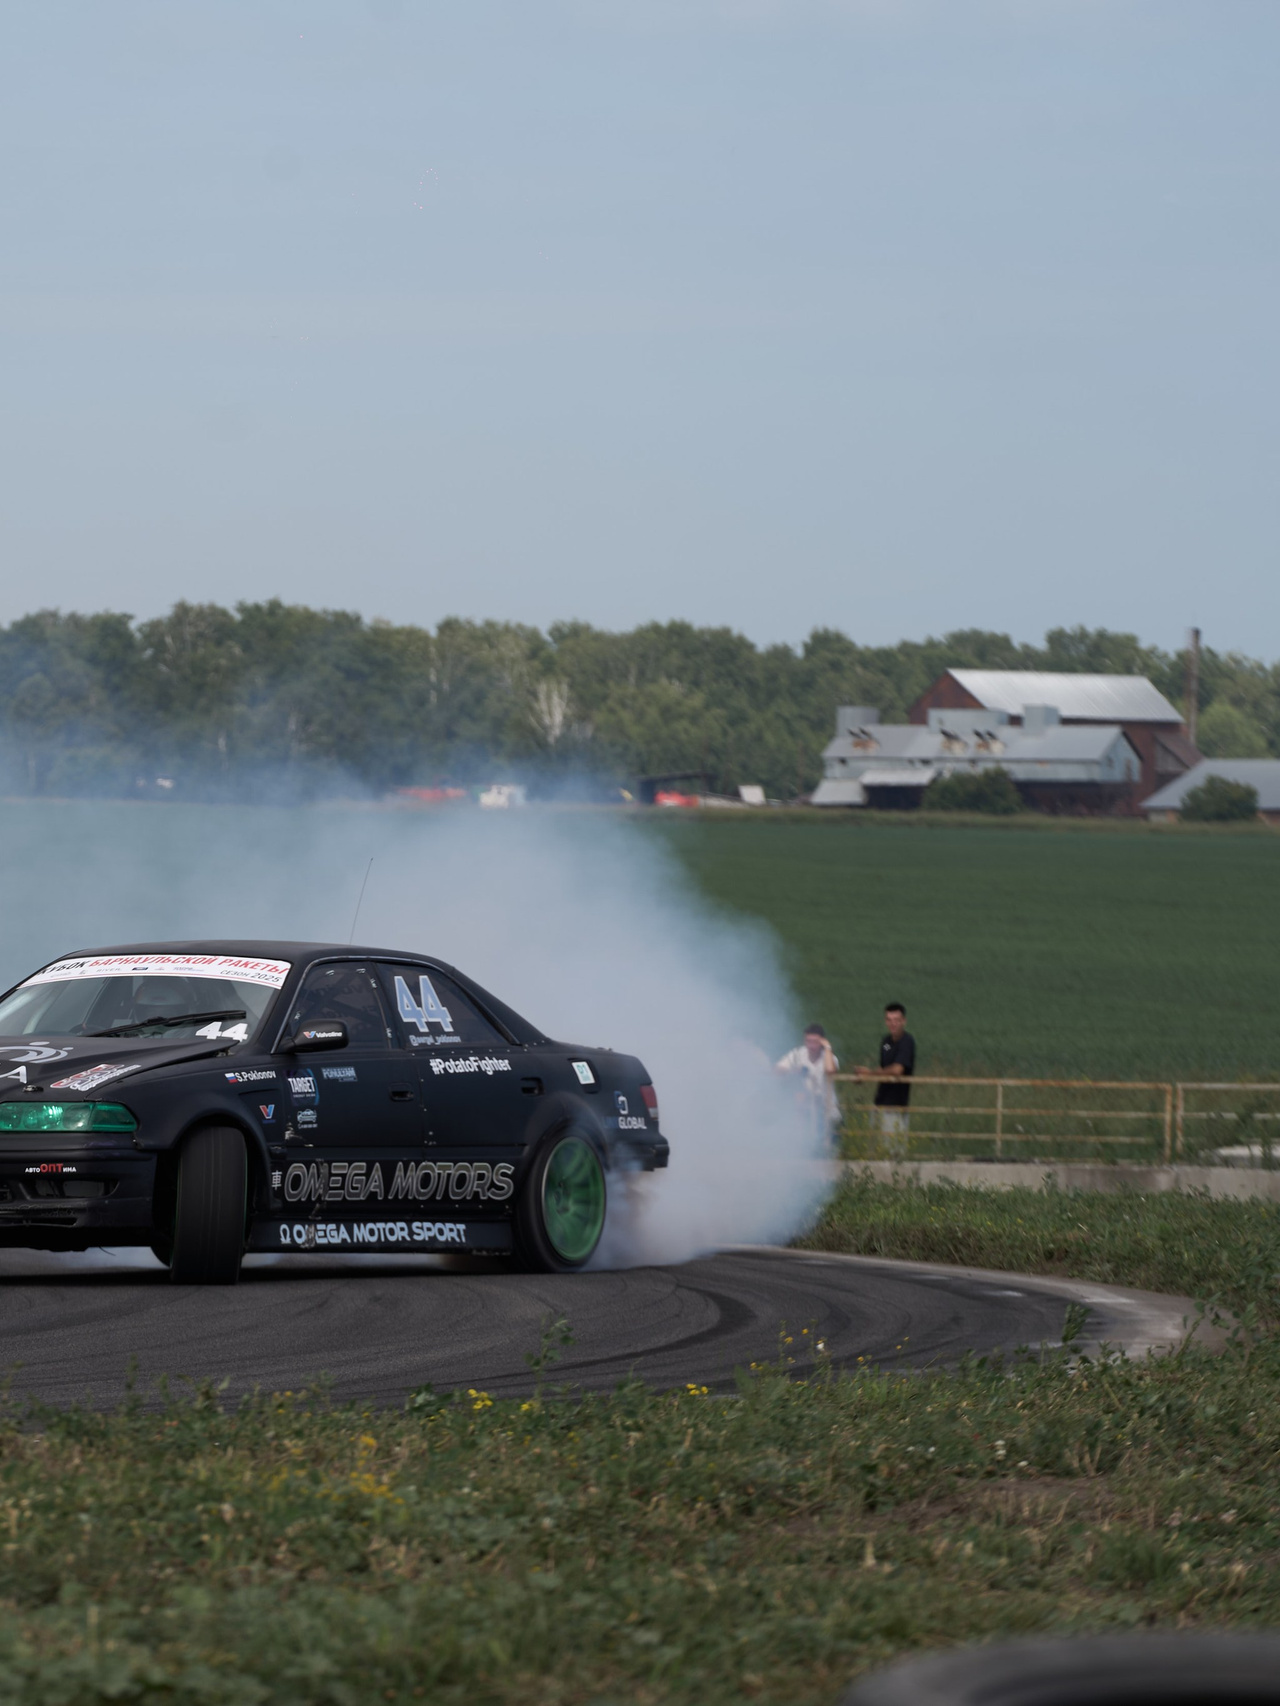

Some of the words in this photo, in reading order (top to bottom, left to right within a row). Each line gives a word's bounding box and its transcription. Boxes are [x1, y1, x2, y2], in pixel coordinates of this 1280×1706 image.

[38, 960, 91, 975] КУБОК
[89, 955, 220, 967] БАРНАУЛЬСКОЙ
[218, 958, 290, 975] РАКЕТЫ
[220, 969, 250, 977] СЕЗОН
[251, 972, 283, 983] 2025
[394, 975, 454, 1032] 44
[195, 1021, 249, 1042] 44
[429, 1056, 512, 1075] #PotatoFighter
[235, 1070, 277, 1082] S.Poklonov
[287, 1077, 316, 1093] TARGET
[388, 1161, 515, 1200] MOTORS
[293, 1223, 351, 1244] OEGA
[353, 1222, 411, 1243] MOTOR
[412, 1222, 467, 1243] SPORT
